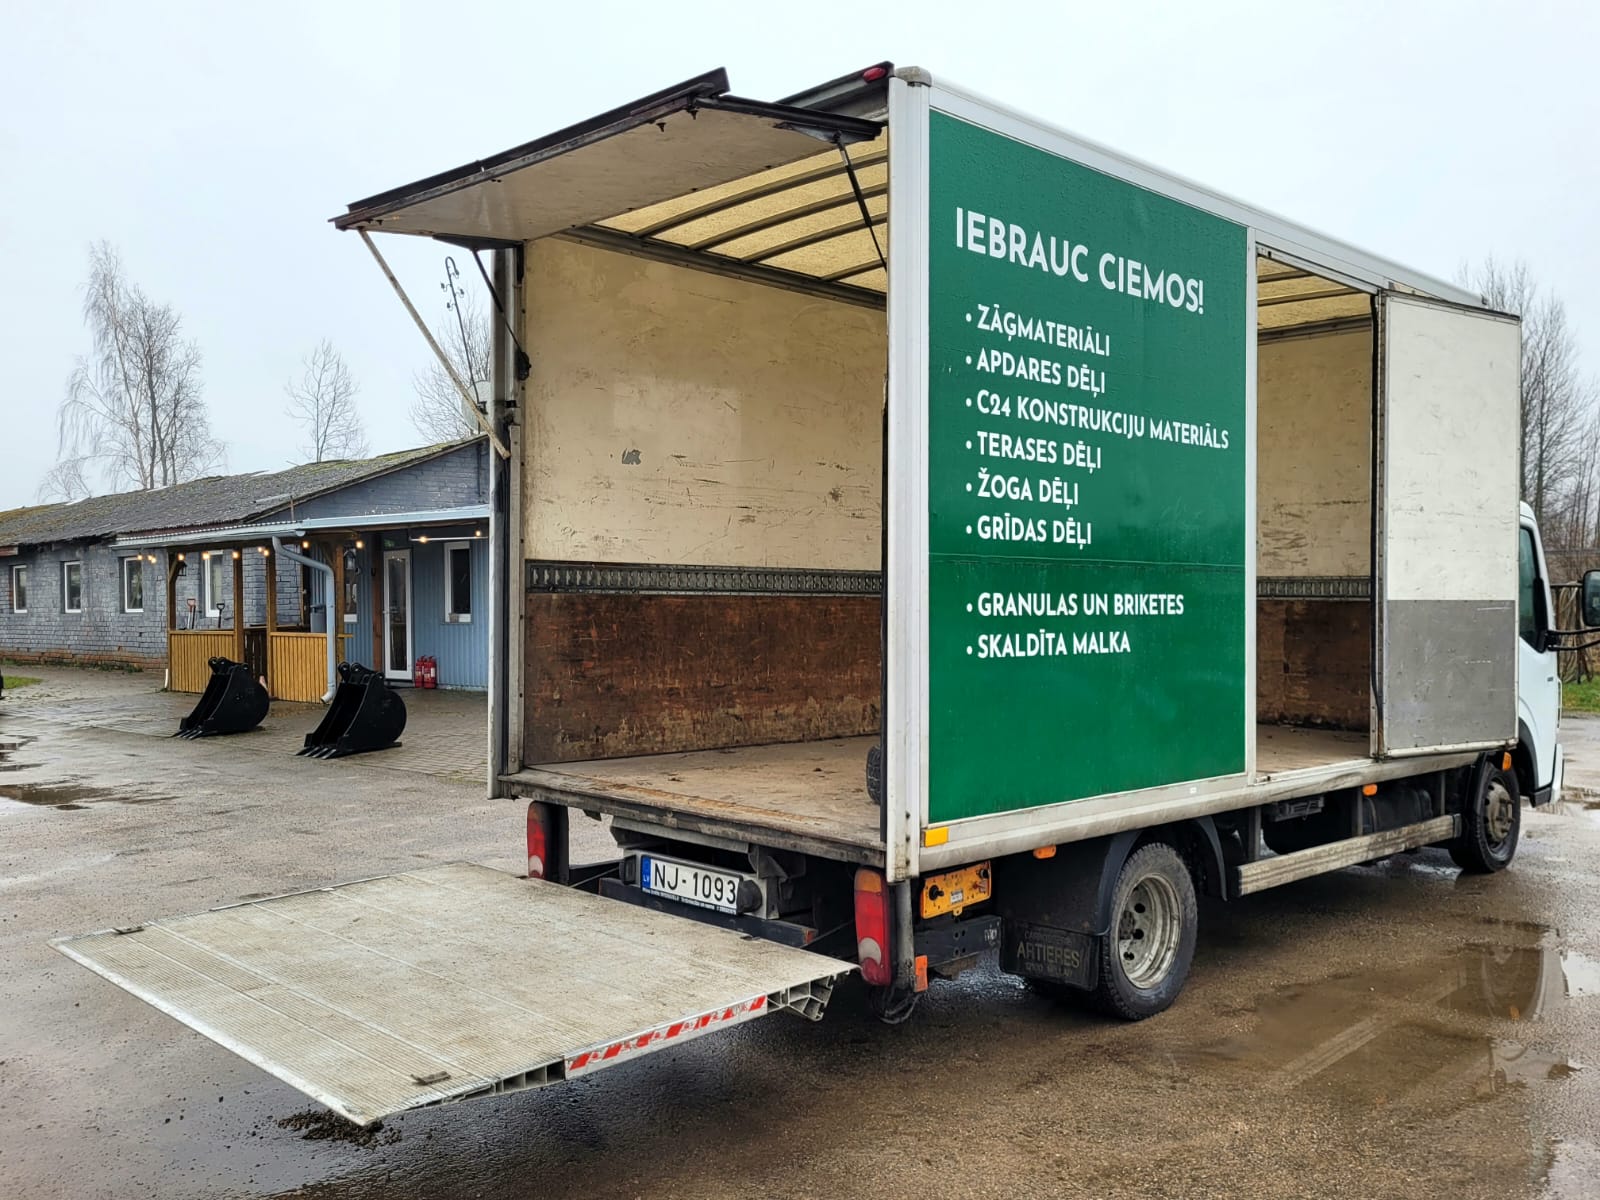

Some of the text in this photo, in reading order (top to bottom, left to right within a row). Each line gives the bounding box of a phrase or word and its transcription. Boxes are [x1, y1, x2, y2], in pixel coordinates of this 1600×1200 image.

[957, 207, 1204, 315] IEBRAUC CIEMOS!
[977, 303, 1110, 357] ZĀĢMATERIĀLI
[976, 347, 1105, 398] APDARES DĒĻI
[976, 389, 1229, 449] C24 KONSTRUKCIJU MATERIĀLS
[976, 430, 1101, 474] TERASES DĒĻI
[977, 467, 1079, 511] ŽOGA DĒĻI
[977, 512, 1092, 550] GRĪDAS DĒĻI
[977, 592, 1184, 617] GRANULAS UN BRIKETES
[977, 628, 1131, 659] SKALDĪTA MALKA
[654, 863, 736, 904] NJ-1093
